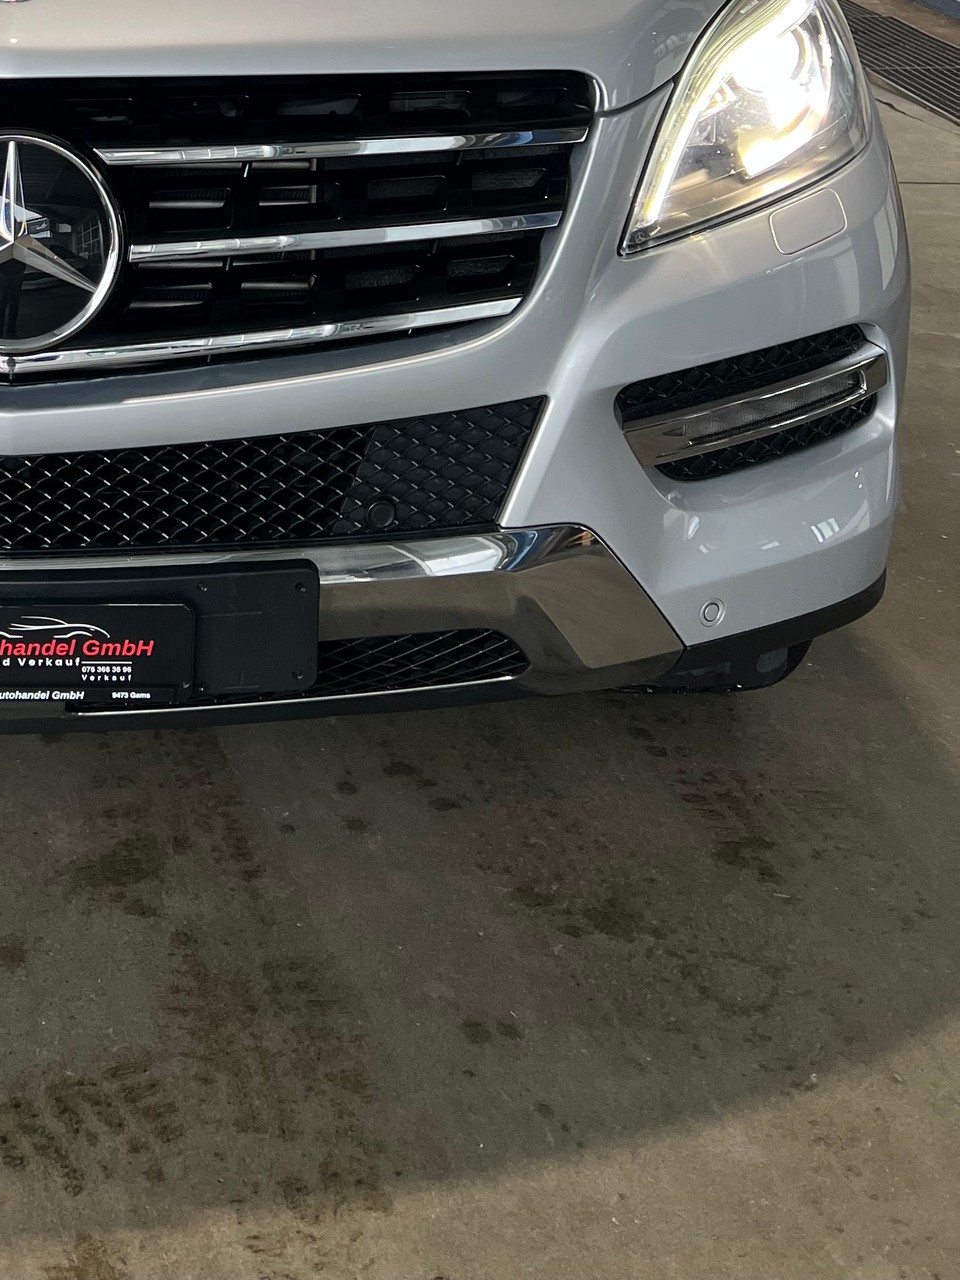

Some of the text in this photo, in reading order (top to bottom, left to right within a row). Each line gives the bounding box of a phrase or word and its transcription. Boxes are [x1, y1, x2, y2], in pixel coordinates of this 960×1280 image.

[82, 640, 154, 656] GmbH
[18, 657, 80, 667] Verkauf
[51, 691, 85, 700] GmbH
